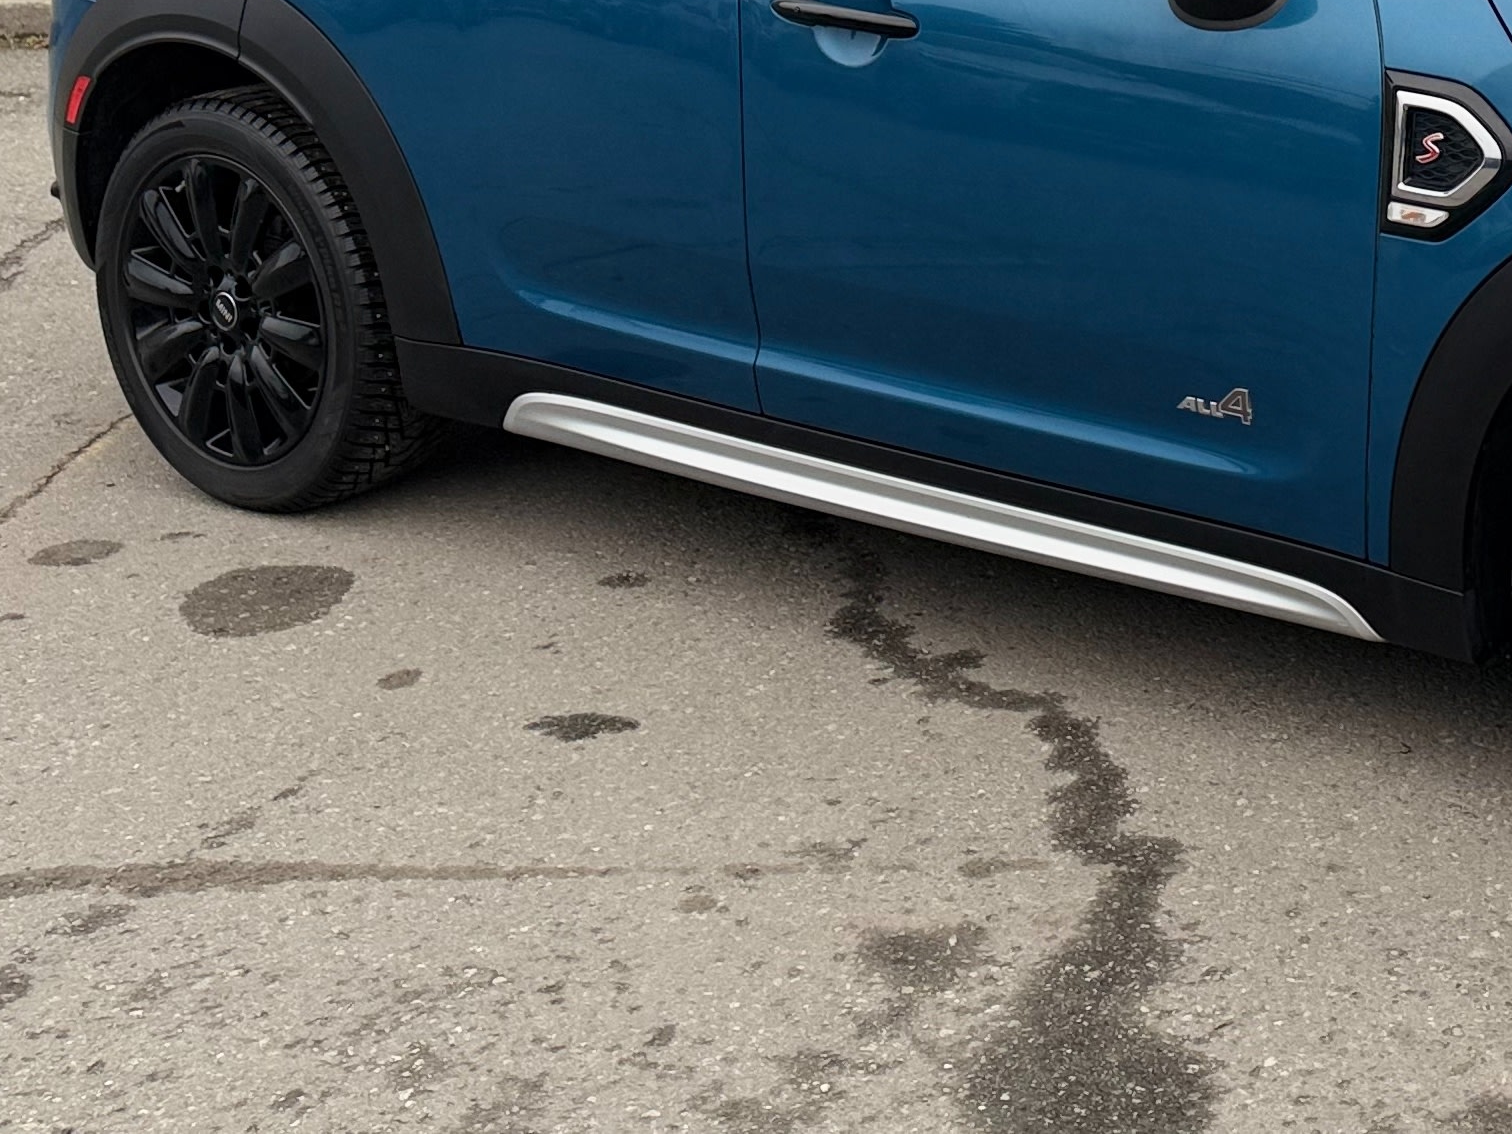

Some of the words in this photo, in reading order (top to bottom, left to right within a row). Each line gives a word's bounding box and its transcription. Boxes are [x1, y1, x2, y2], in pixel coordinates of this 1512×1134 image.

[1415, 132, 1445, 164] S
[215, 298, 233, 323] MINI
[1176, 387, 1253, 426] ALL4
